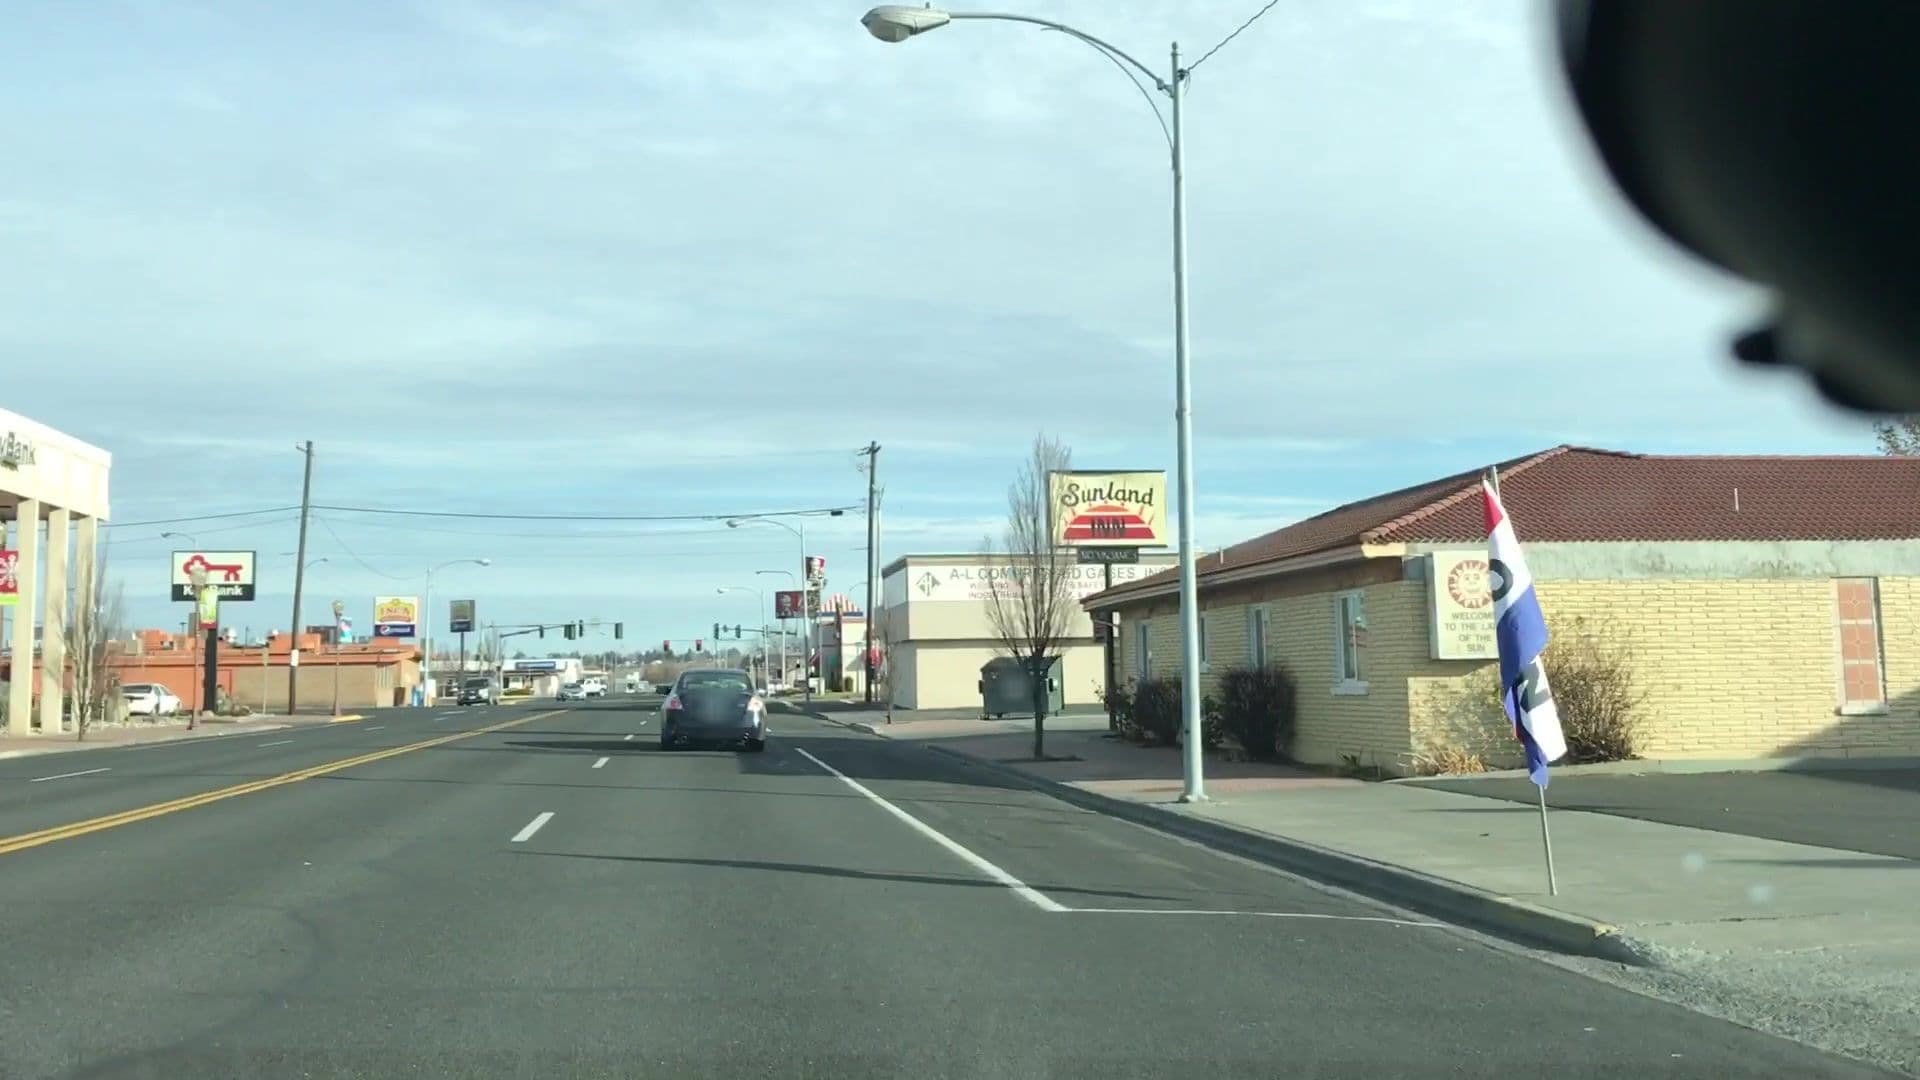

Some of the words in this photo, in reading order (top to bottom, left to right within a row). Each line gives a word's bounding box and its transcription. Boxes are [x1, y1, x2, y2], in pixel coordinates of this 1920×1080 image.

[1061, 481, 1154, 507] Sunland
[1090, 518, 1127, 536] INN
[950, 568, 973, 579] A-L
[1086, 567, 1135, 580] GASES
[183, 585, 243, 596] Kank
[1451, 612, 1493, 620] WELCOM
[1444, 622, 1456, 631] TO
[1461, 622, 1476, 631] THE
[1458, 634, 1469, 642] OF
[1476, 634, 1492, 642] THE
[1467, 643, 1486, 652] SUN
